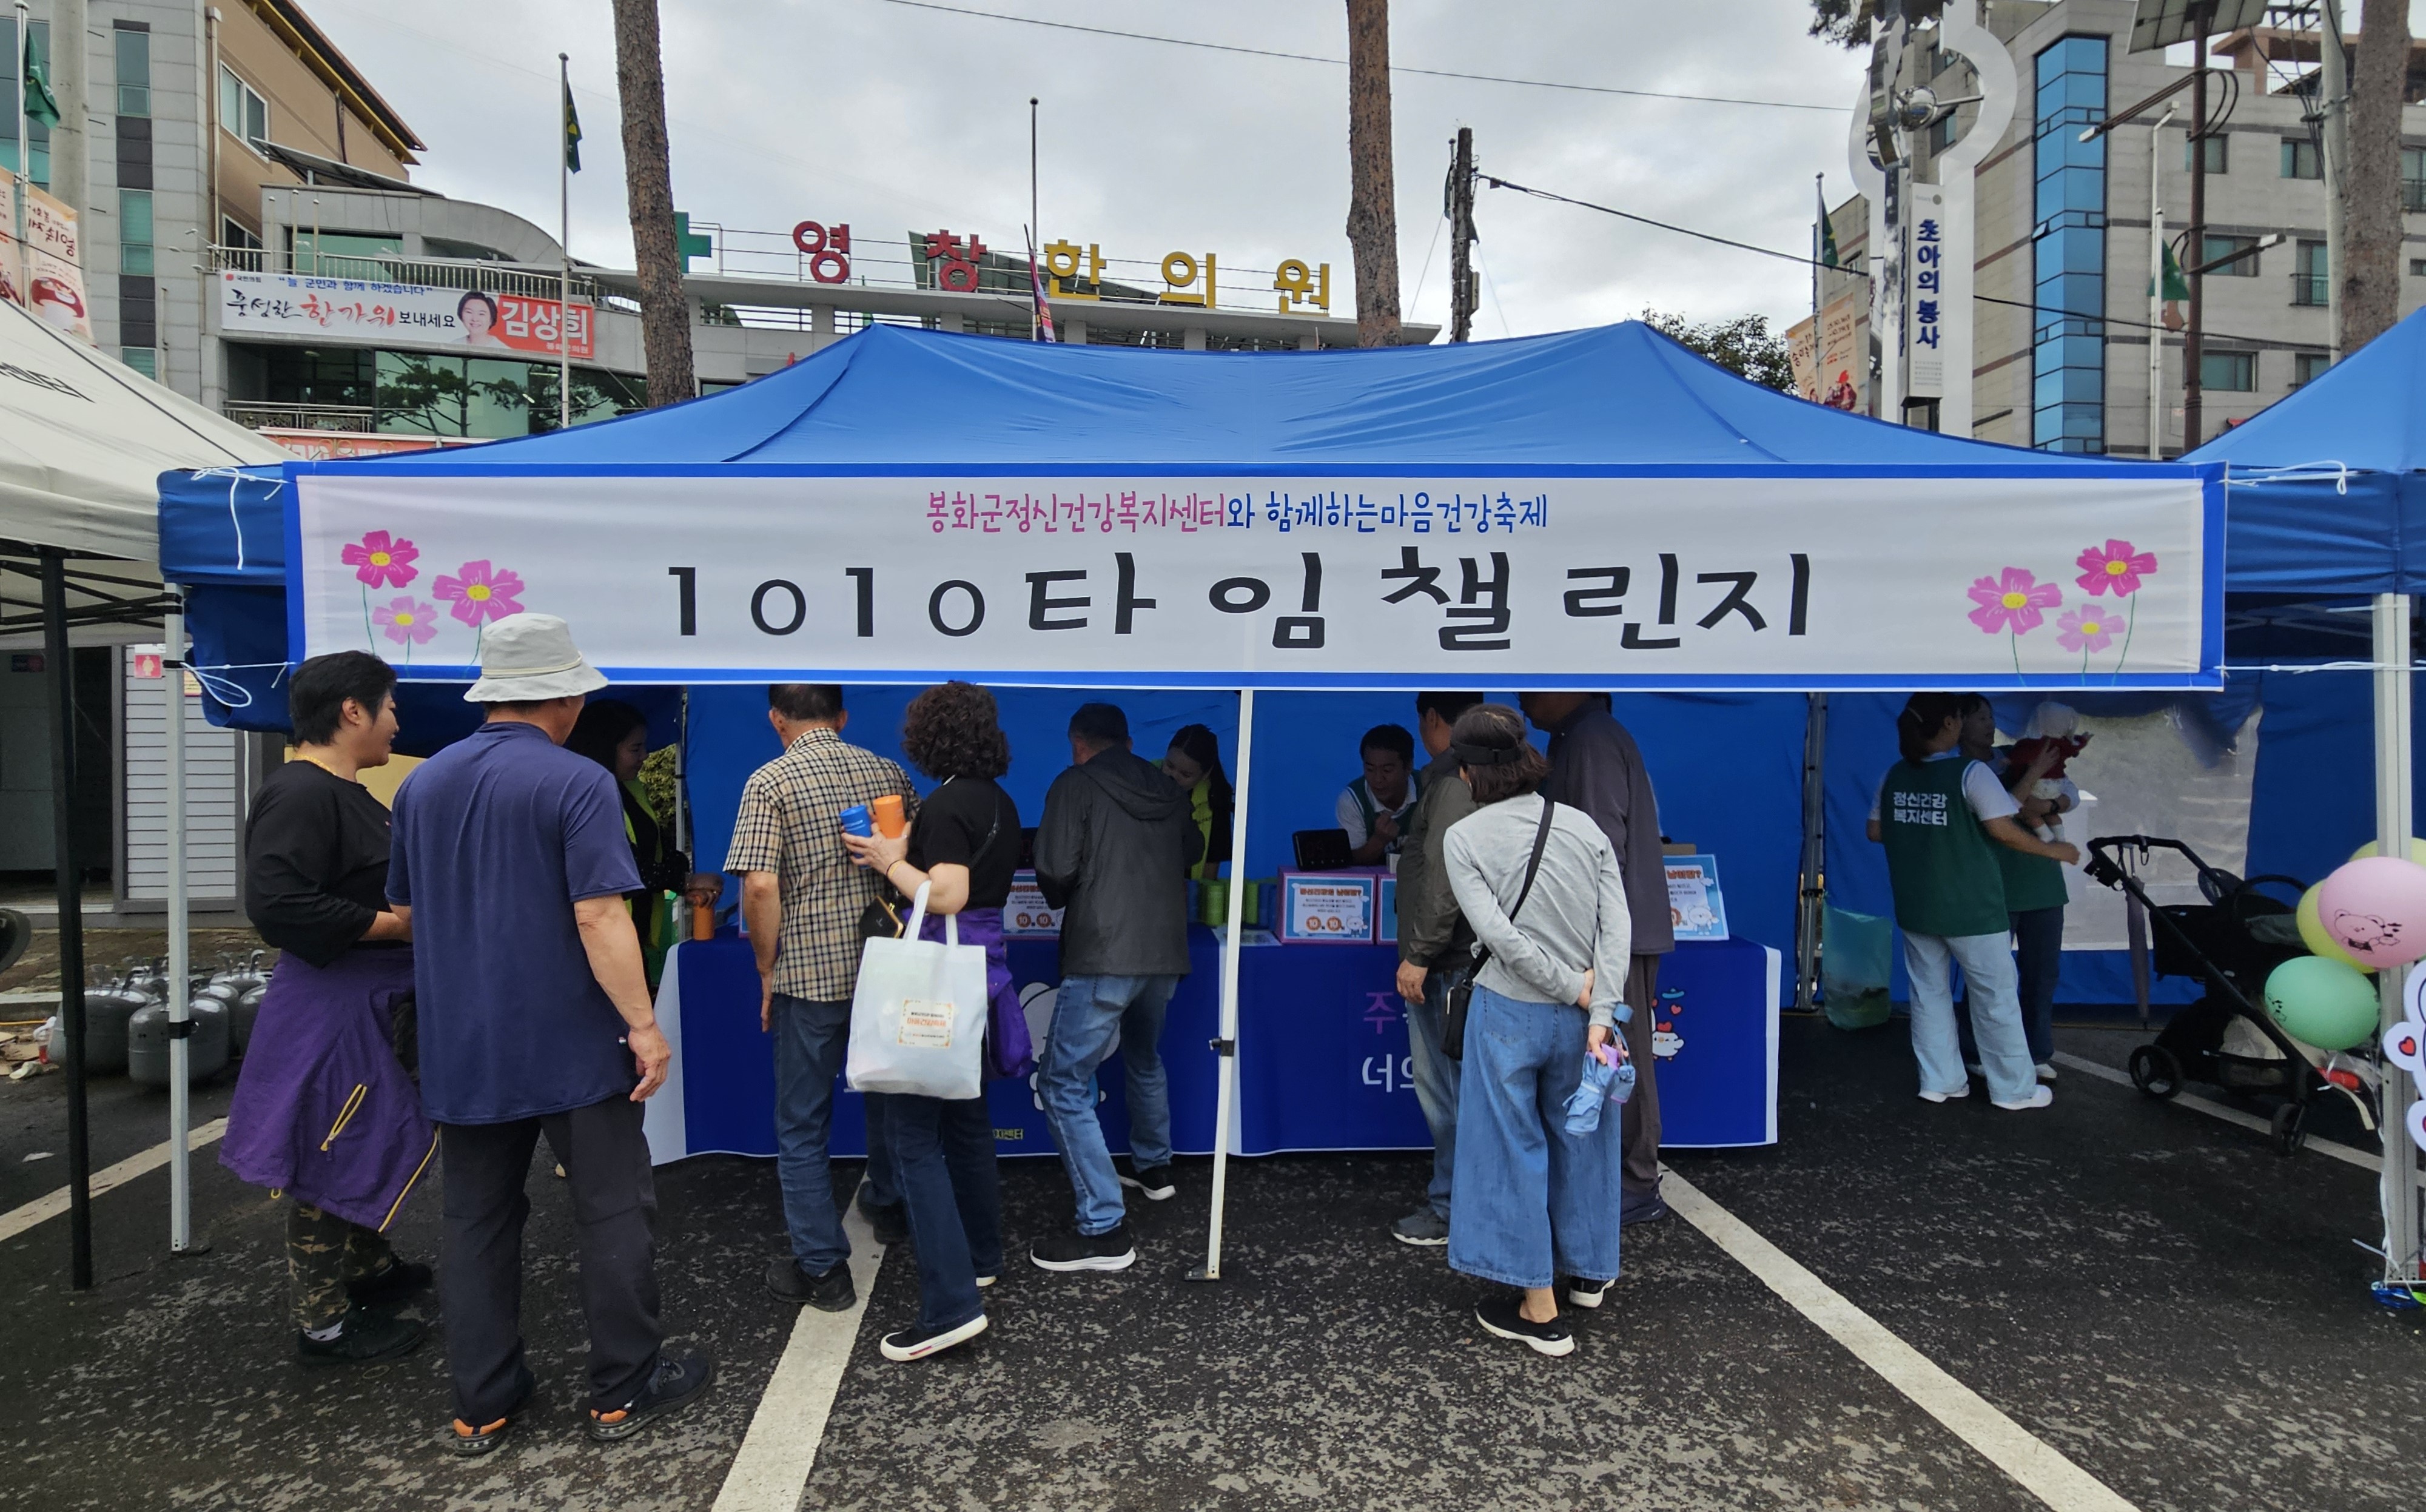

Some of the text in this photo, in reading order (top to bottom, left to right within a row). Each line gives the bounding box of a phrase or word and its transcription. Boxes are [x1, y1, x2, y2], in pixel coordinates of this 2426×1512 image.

[304, 278, 337, 289] 군민과
[343, 281, 365, 291] 함께
[226, 288, 455, 328] 풍성한 한가위 보내세요
[502, 301, 588, 345] 김상희
[926, 490, 1548, 534] 봉화군정신건강복지센터와 함께하는마음건강축제
[1893, 791, 1948, 808] 정신건강
[1894, 808, 1947, 826] 복지센터
